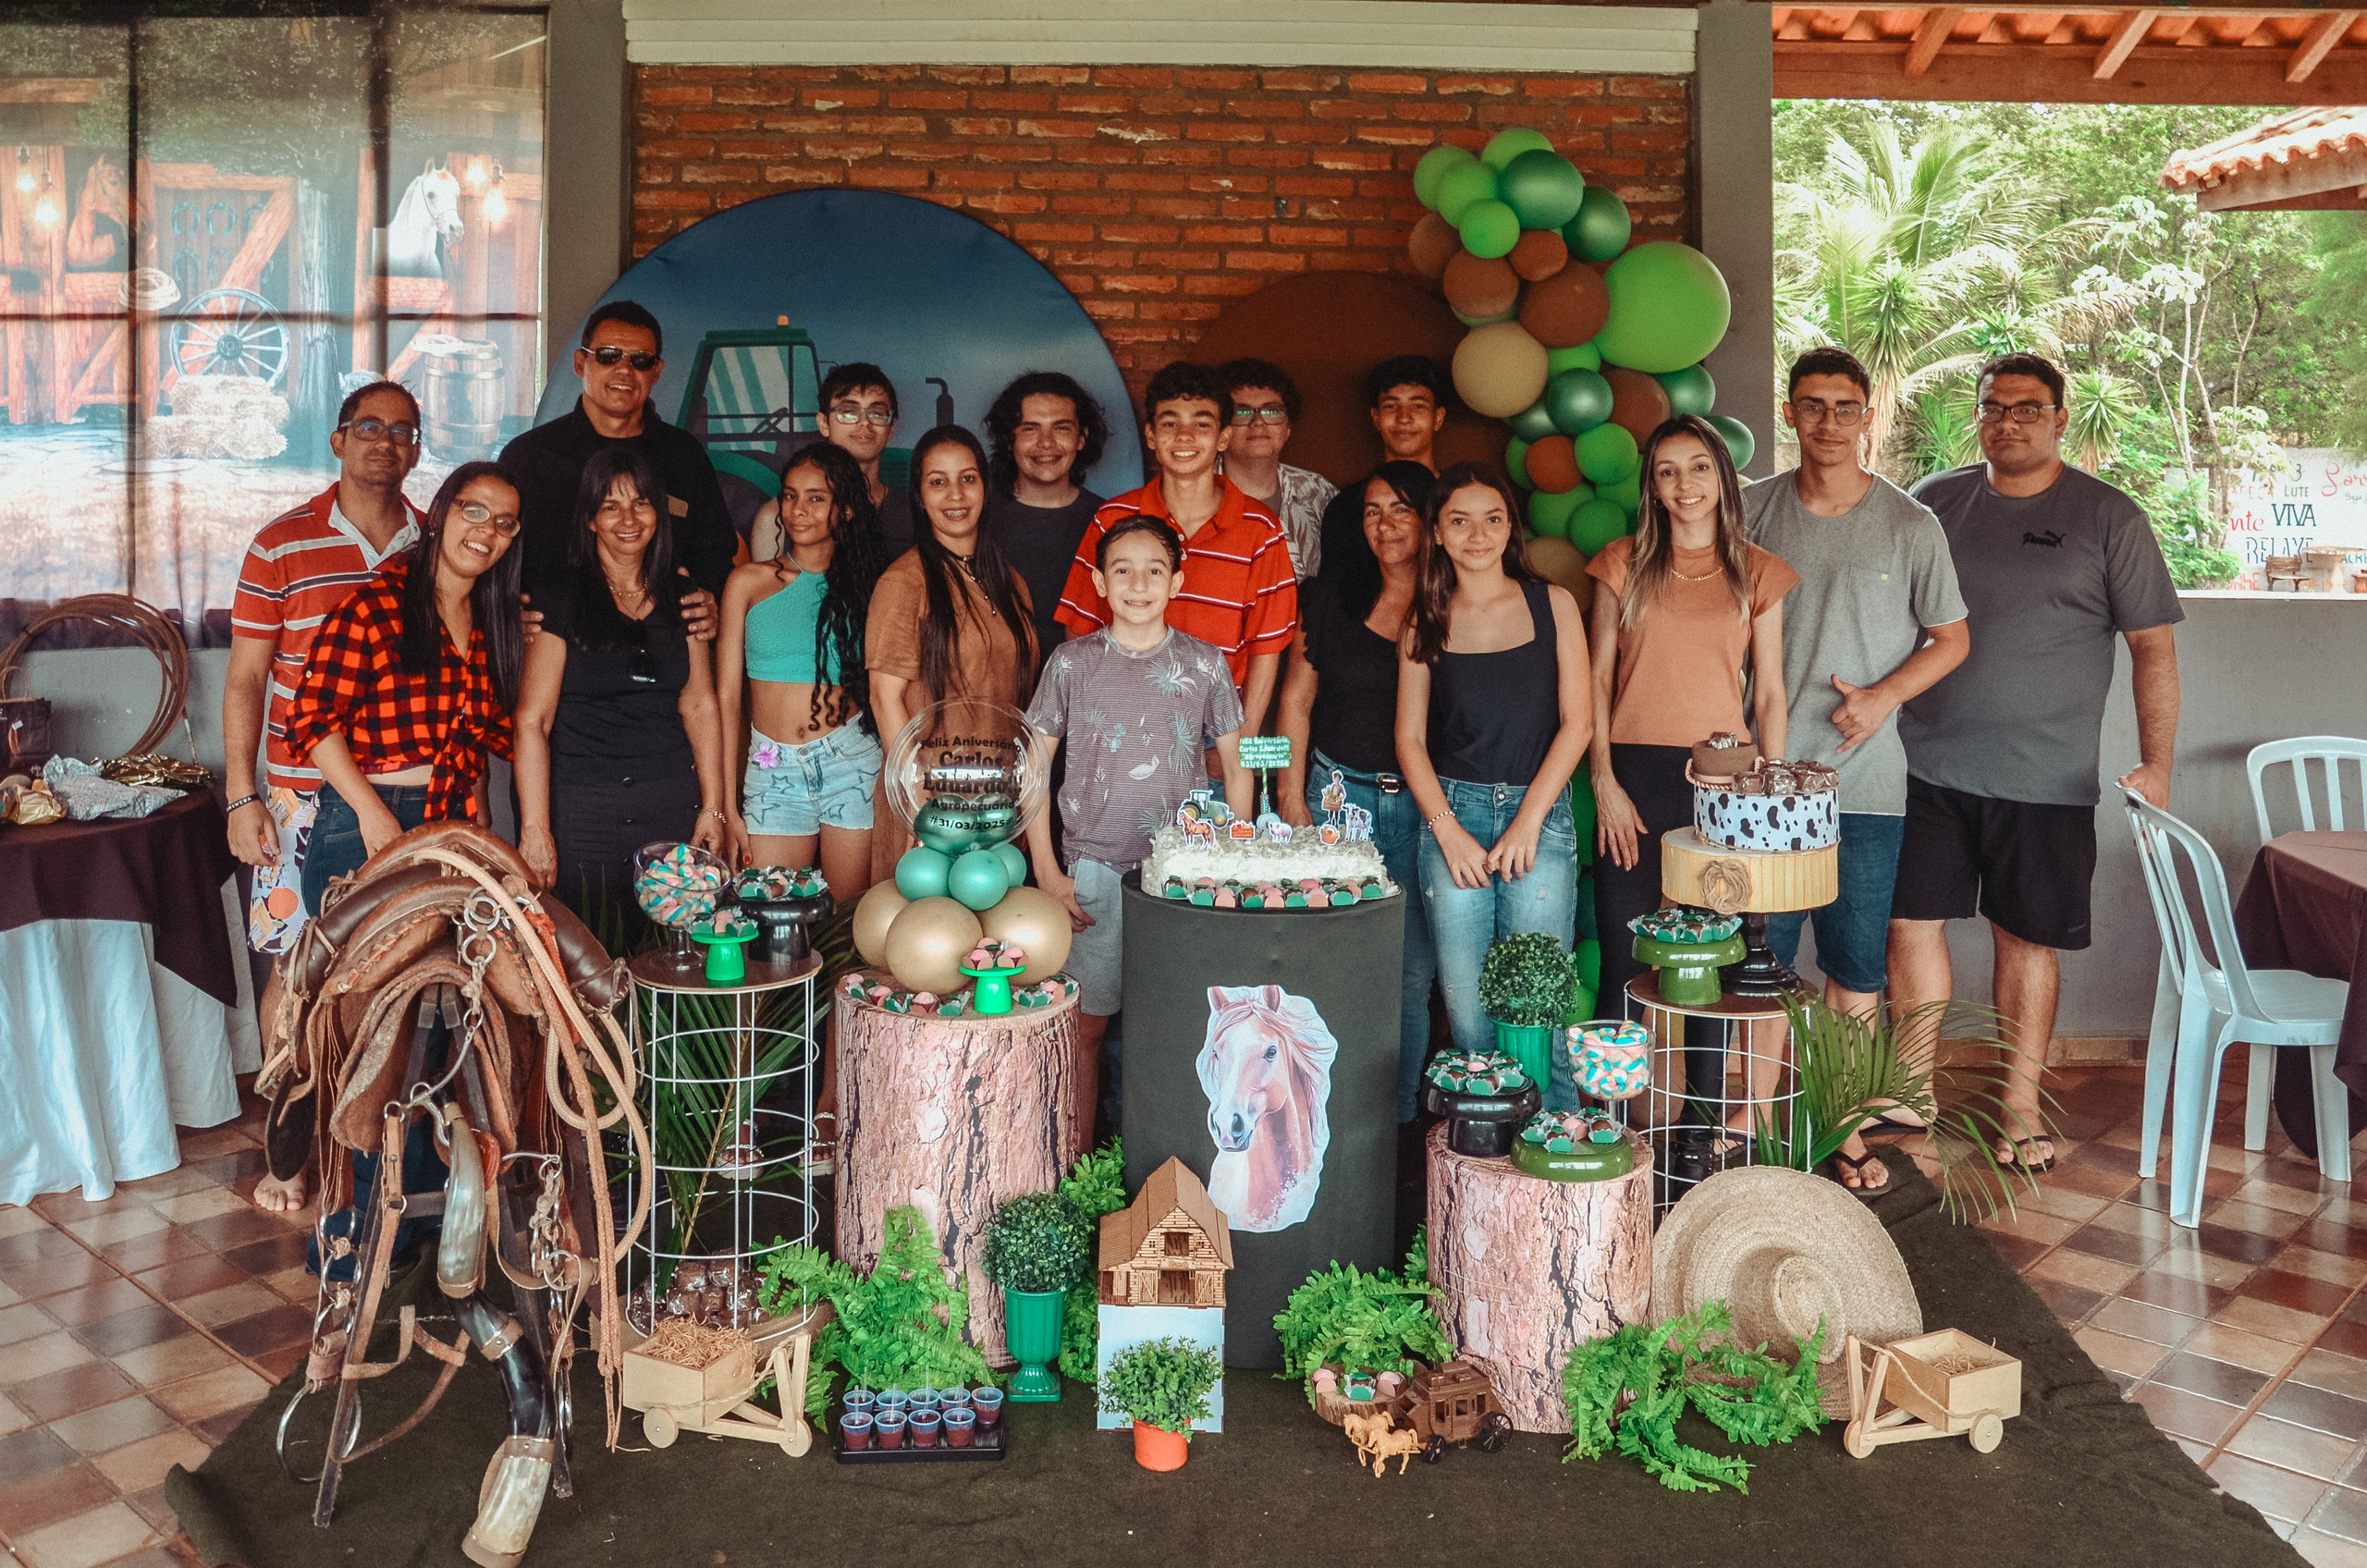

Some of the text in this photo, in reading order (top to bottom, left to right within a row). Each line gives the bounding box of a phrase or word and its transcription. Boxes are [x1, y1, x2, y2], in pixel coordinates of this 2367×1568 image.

[2285, 485, 2310, 497] LUTE
[2230, 510, 2264, 532] nte
[2271, 503, 2317, 527] VIVA
[922, 736, 1022, 752] Feliz Aniversário
[939, 751, 1003, 768] Carlos
[929, 815, 1015, 830] #31/03/2025#
